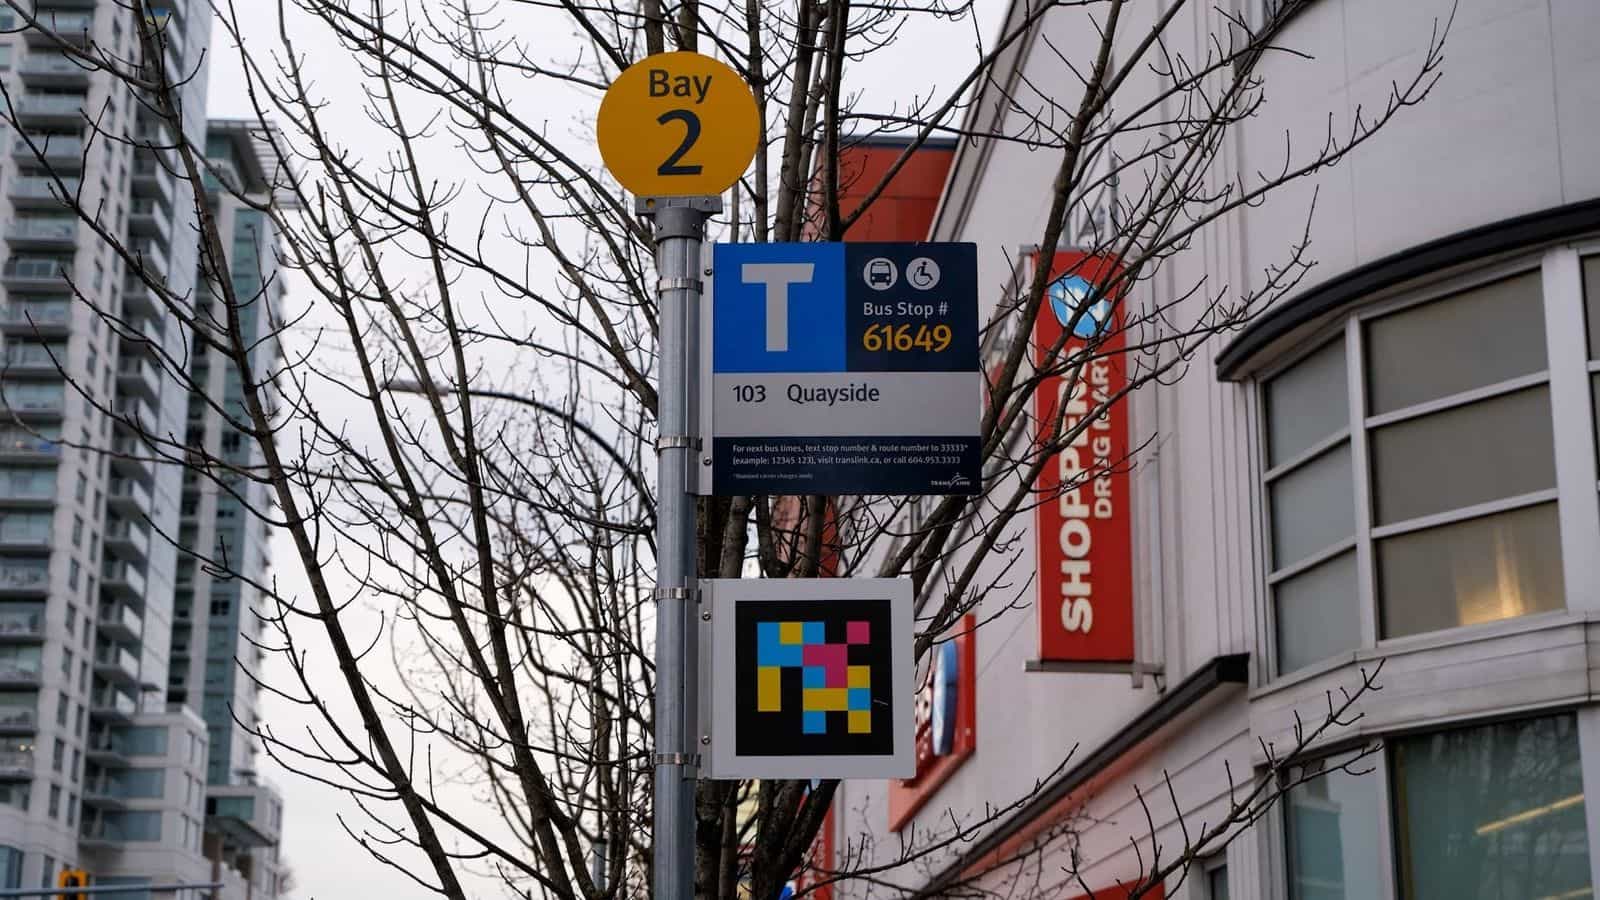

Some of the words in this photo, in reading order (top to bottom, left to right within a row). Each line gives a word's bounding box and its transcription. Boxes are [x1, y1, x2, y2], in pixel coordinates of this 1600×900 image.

[649, 69, 713, 105] Bay
[656, 109, 704, 176] 2
[741, 263, 815, 352] T
[863, 302, 893, 316] Bus
[897, 302, 934, 319] Stop
[938, 302, 948, 315] #
[863, 323, 952, 353] 61649
[732, 384, 767, 403] 103
[786, 382, 880, 406] Quayside
[732, 444, 745, 453] For
[746, 444, 763, 453] next
[764, 444, 779, 453] bus
[780, 444, 804, 454] times,
[805, 444, 821, 453] text
[822, 444, 839, 454] stop
[840, 444, 869, 453] number
[870, 444, 878, 453] &
[880, 444, 899, 453] route
[900, 444, 929, 453] number
[930, 444, 939, 453] to
[772, 456, 796, 465] 12345
[817, 456, 834, 465] visit
[883, 456, 891, 465] or
[892, 456, 906, 465] call
[1056, 346, 1093, 633] SHOPPERS
[1093, 436, 1112, 518] DRUG
